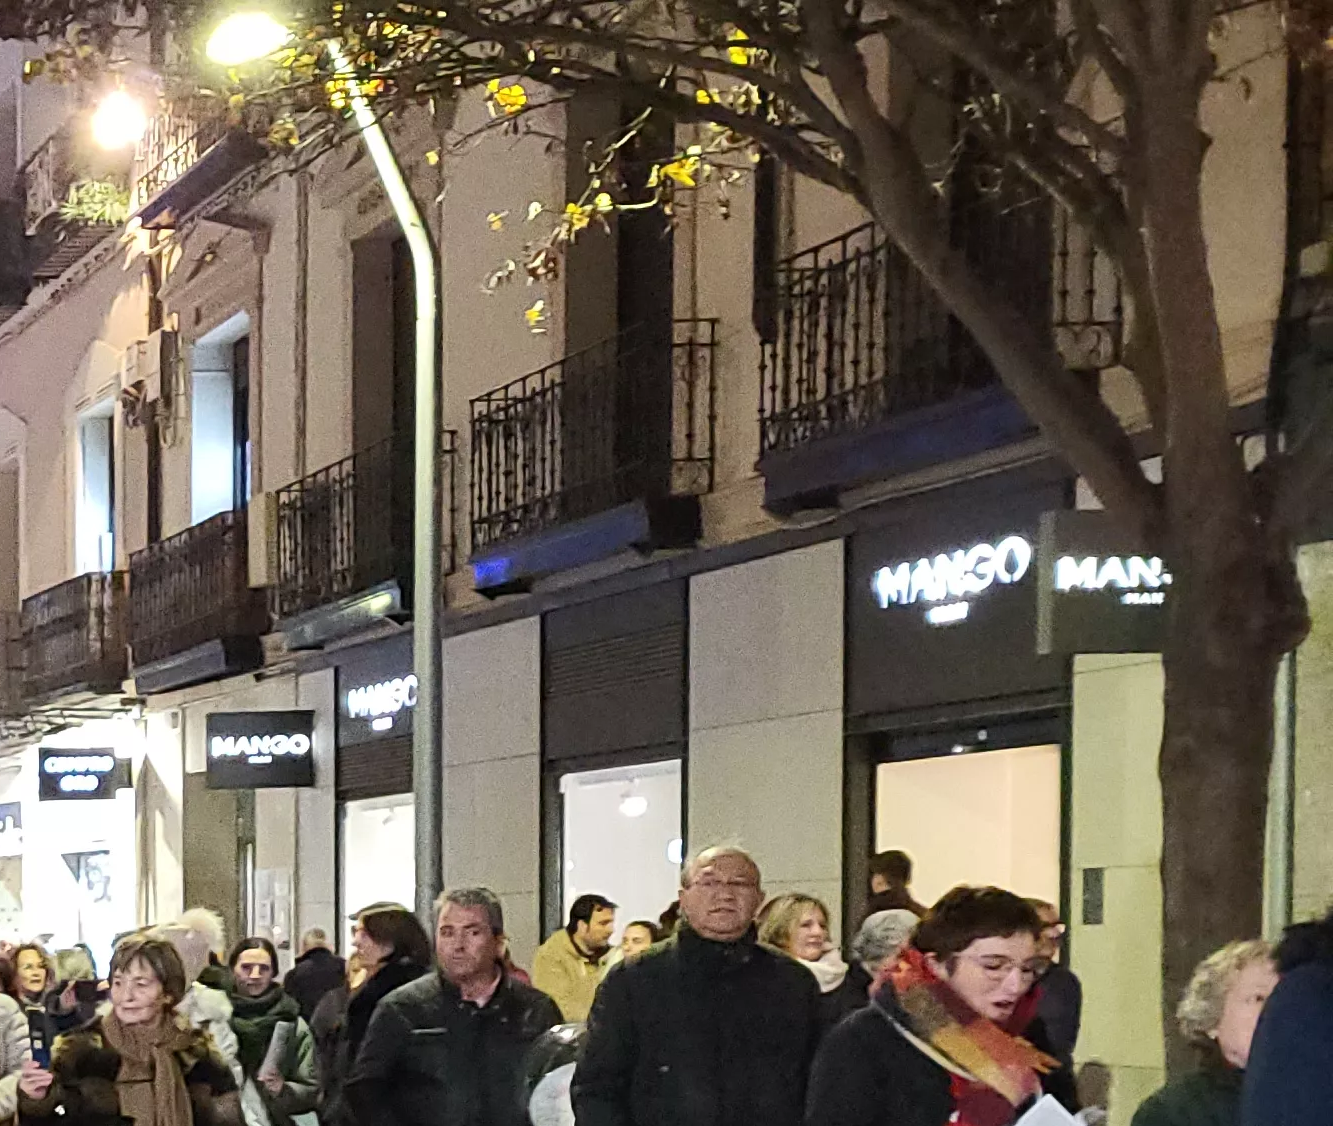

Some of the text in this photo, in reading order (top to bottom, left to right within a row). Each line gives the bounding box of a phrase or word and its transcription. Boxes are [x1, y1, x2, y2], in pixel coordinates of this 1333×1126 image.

[876, 535, 1032, 608] MANGO
[1054, 556, 1173, 592] MAN
[211, 733, 311, 758] MANGO
